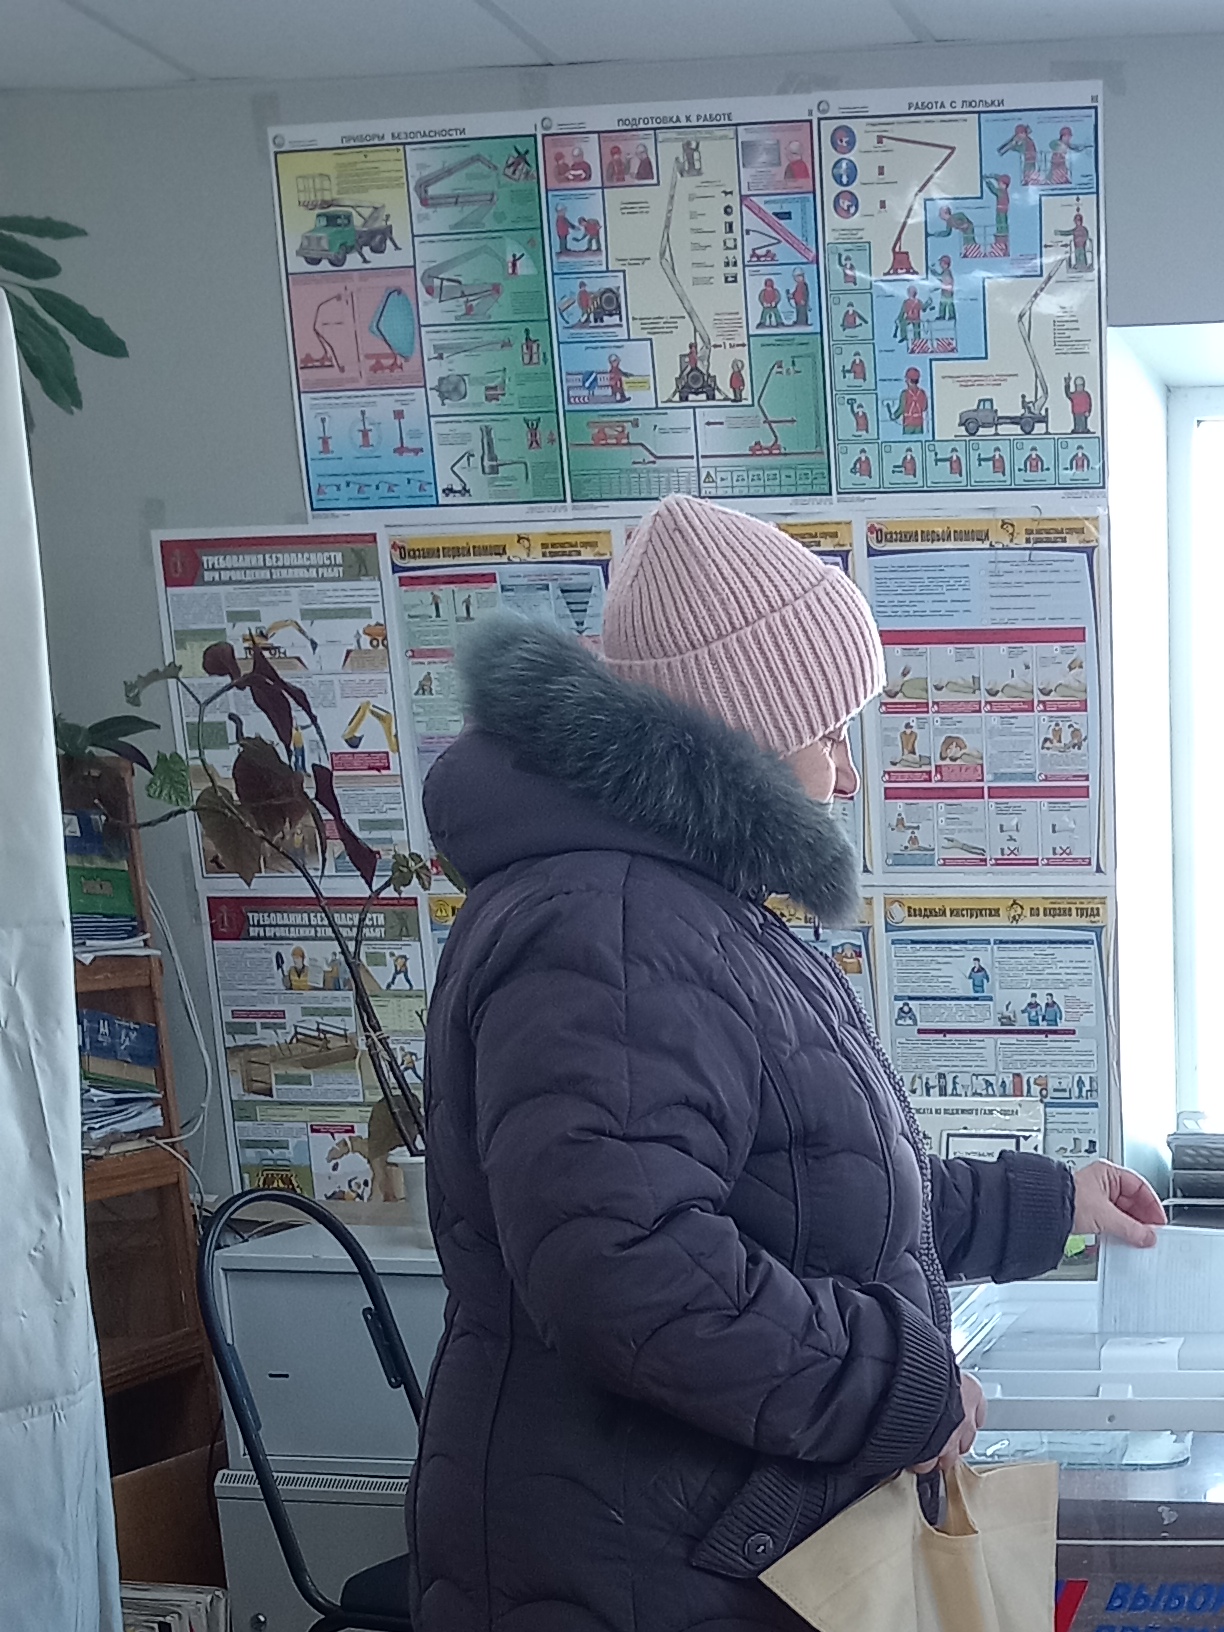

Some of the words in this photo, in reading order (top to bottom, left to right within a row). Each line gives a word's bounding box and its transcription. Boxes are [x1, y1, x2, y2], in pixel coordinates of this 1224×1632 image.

[908, 100, 946, 111] РАБОТА
[949, 100, 957, 109] С
[960, 98, 1005, 109] ЛЮЛЬКИ
[617, 114, 682, 128] ПОДГОТОВКА
[685, 114, 692, 123] К
[696, 112, 733, 123] РАБОТЕ
[341, 132, 385, 144] ПРИБОРЫ
[390, 127, 466, 141] БЕЗОПАСНОСТИ
[874, 527, 919, 545] Оказание
[920, 526, 951, 545] первой
[953, 527, 990, 545] помощи
[201, 554, 264, 570] ТРЕБОВАНИЯ
[265, 551, 343, 567] БЕЗОПАСНОСТИ
[203, 569, 220, 582] ПРИ
[318, 566, 344, 578] РАБОТ
[247, 912, 309, 926] ТРЕБОВАНИЯ
[906, 905, 947, 919] Вводный
[949, 906, 1001, 921] инструктаж
[1029, 906, 1040, 918] по
[1042, 905, 1073, 920] охране
[1075, 905, 1101, 919] труда
[250, 927, 264, 937] ПРИ
[265, 926, 315, 938] ПРОВЕДЕНИИ
